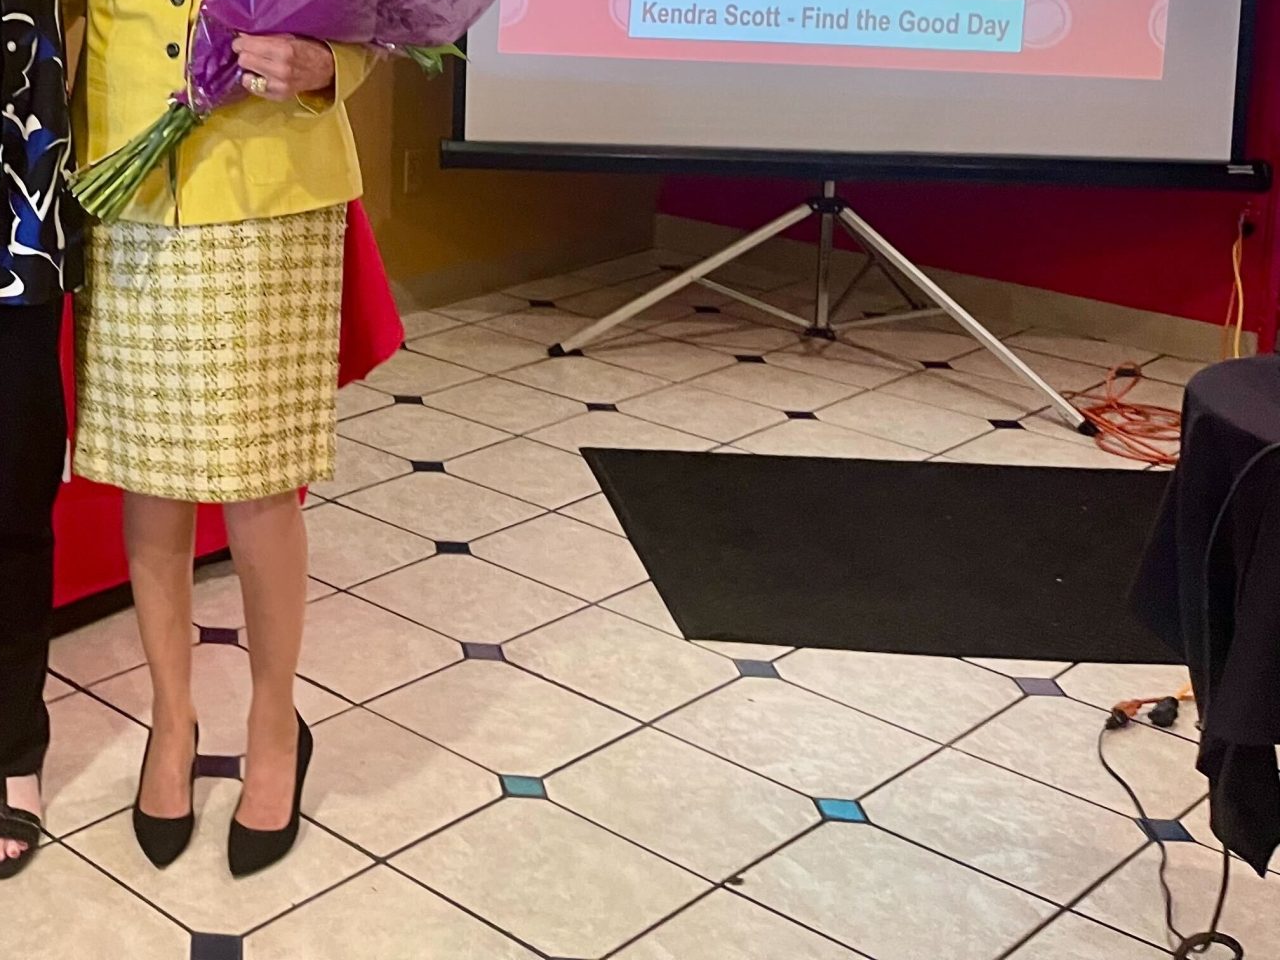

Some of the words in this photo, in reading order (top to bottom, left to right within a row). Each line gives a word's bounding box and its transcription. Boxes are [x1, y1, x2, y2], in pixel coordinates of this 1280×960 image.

[642, 1, 717, 25] Kendra
[724, 4, 780, 28] Scott
[802, 6, 849, 30] Find
[856, 9, 890, 32] the
[898, 10, 960, 35] Good
[967, 13, 1010, 42] Day
